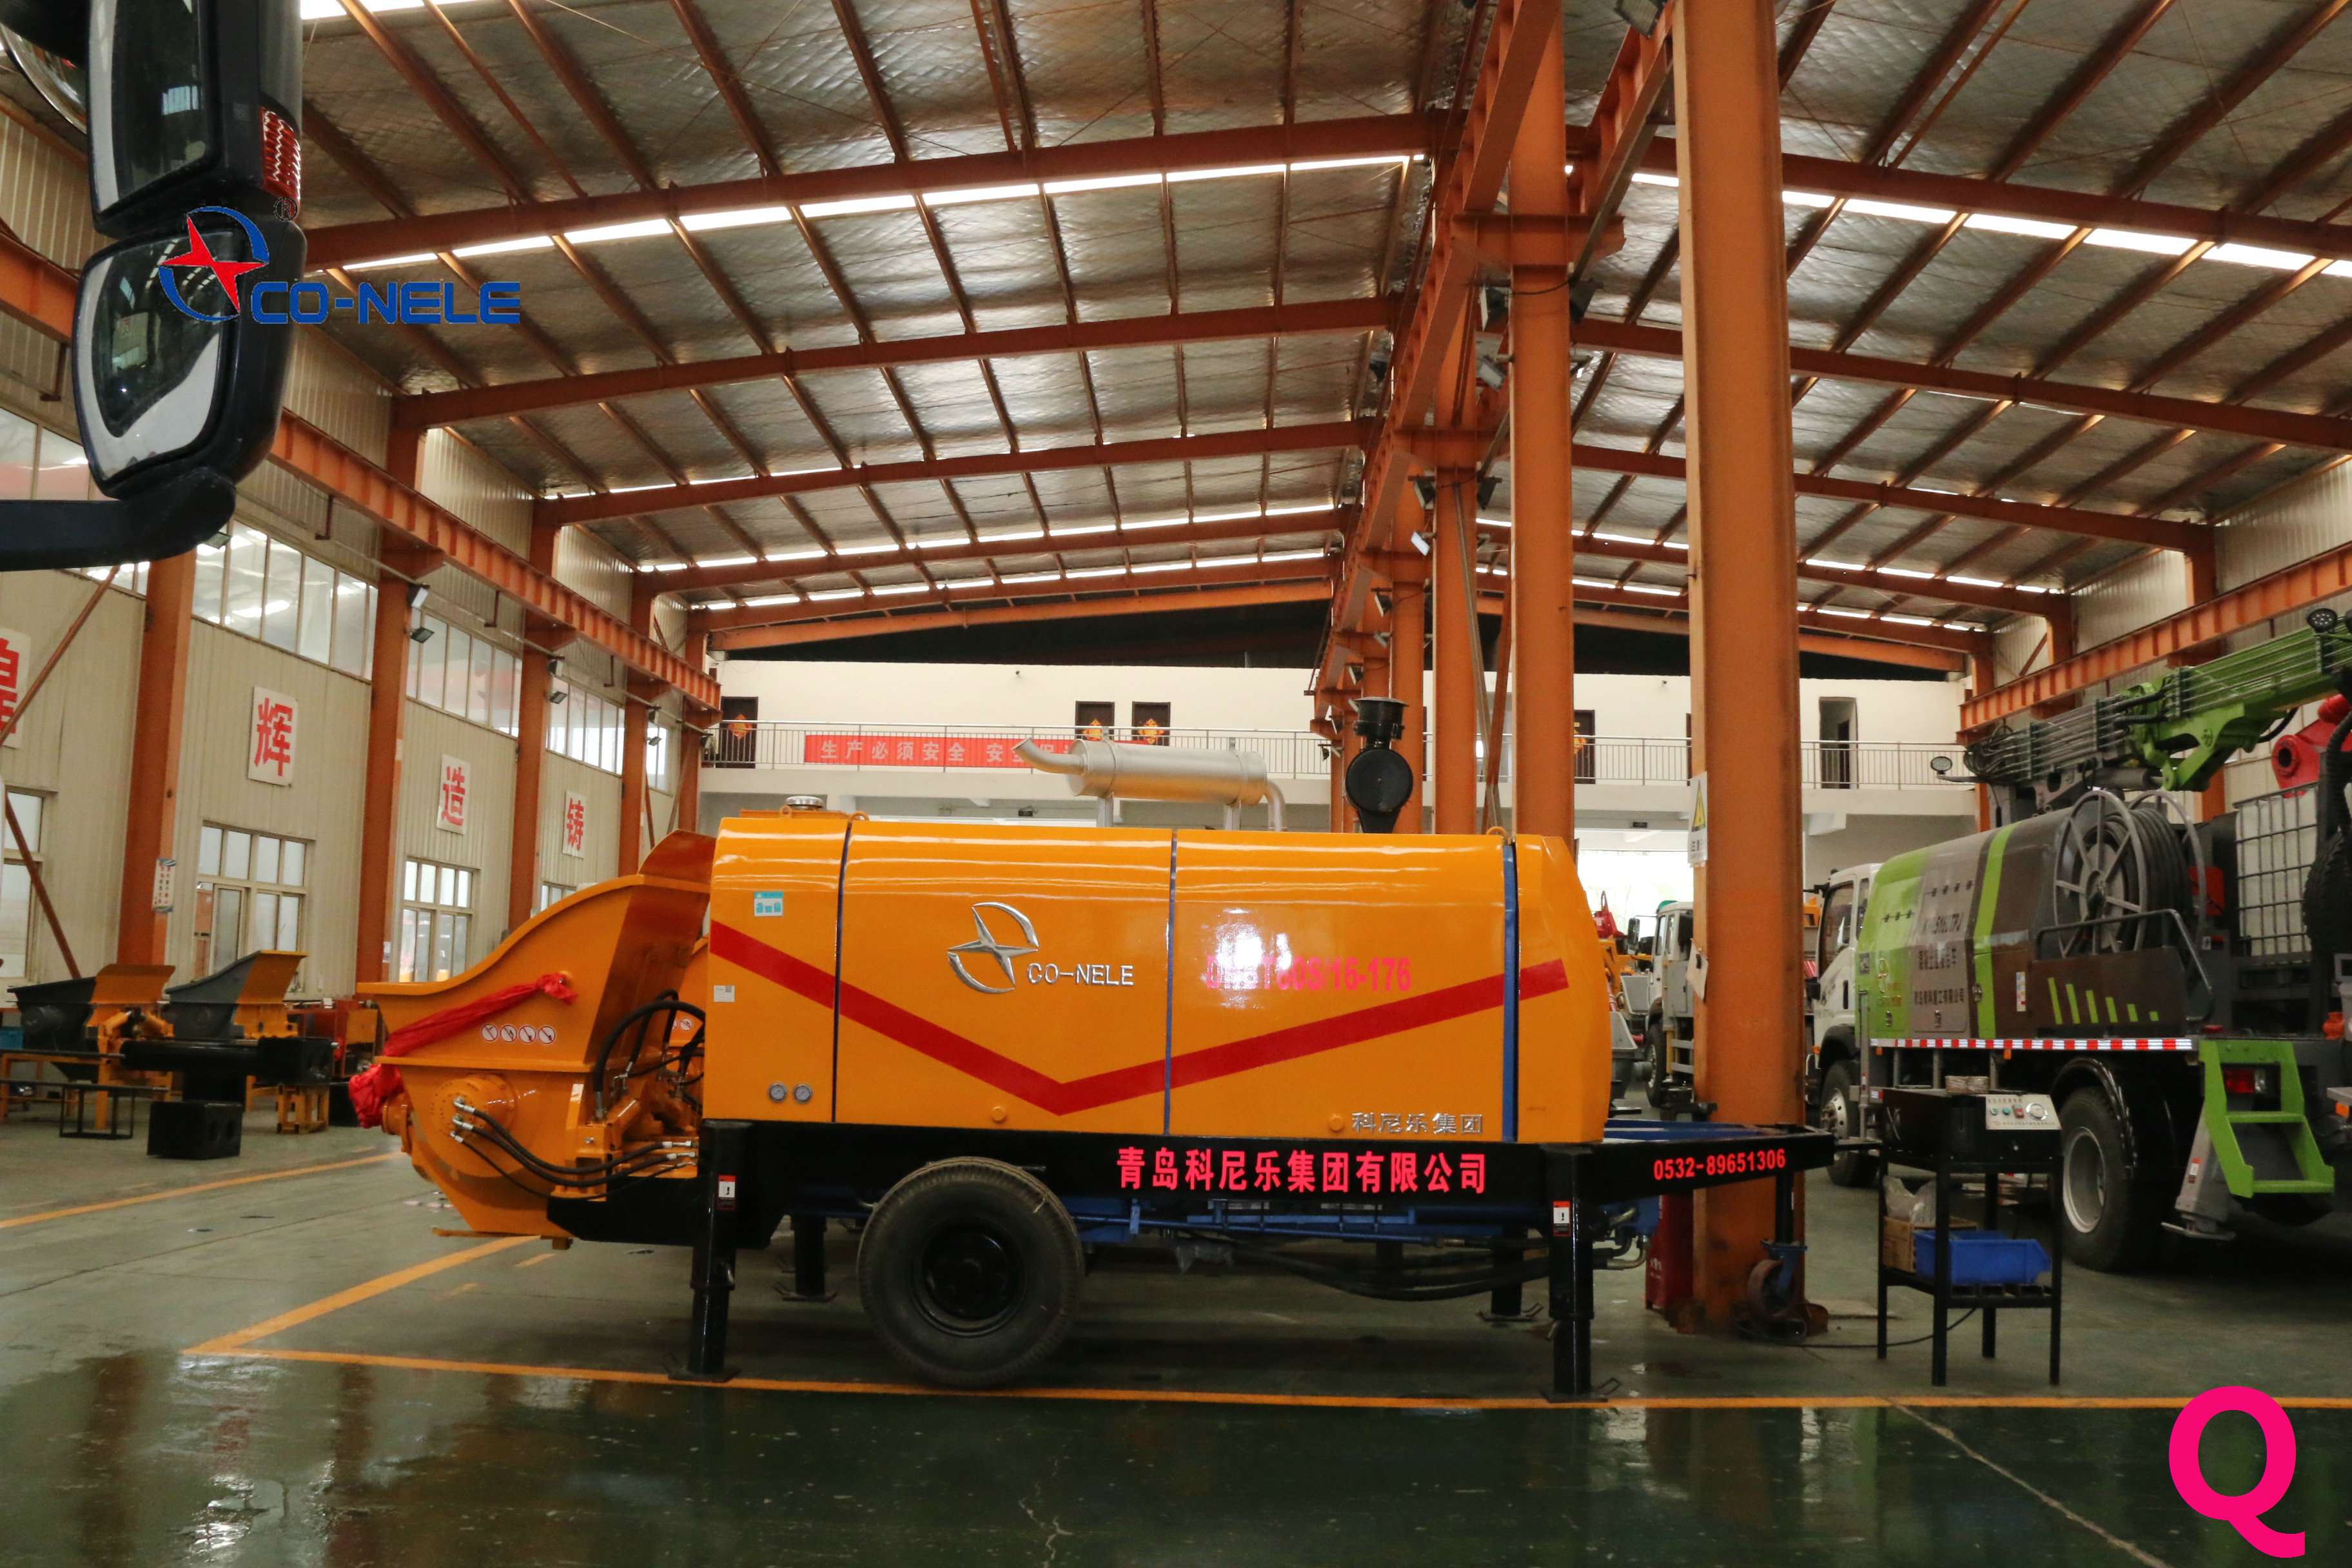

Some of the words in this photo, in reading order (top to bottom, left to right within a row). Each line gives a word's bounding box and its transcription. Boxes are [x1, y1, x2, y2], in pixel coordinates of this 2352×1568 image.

[254, 697, 293, 776] 辉
[820, 740, 966, 763] 生产必须安全
[442, 765, 466, 827] 造
[567, 798, 584, 851] 铸
[1027, 963, 1134, 986] CO-NELE
[1351, 1112, 1483, 1135] 科尼乐集团
[1117, 1146, 1485, 1195] 青岛科尼乐集团有限公司
[1653, 1148, 1786, 1181] 0532-89651306
